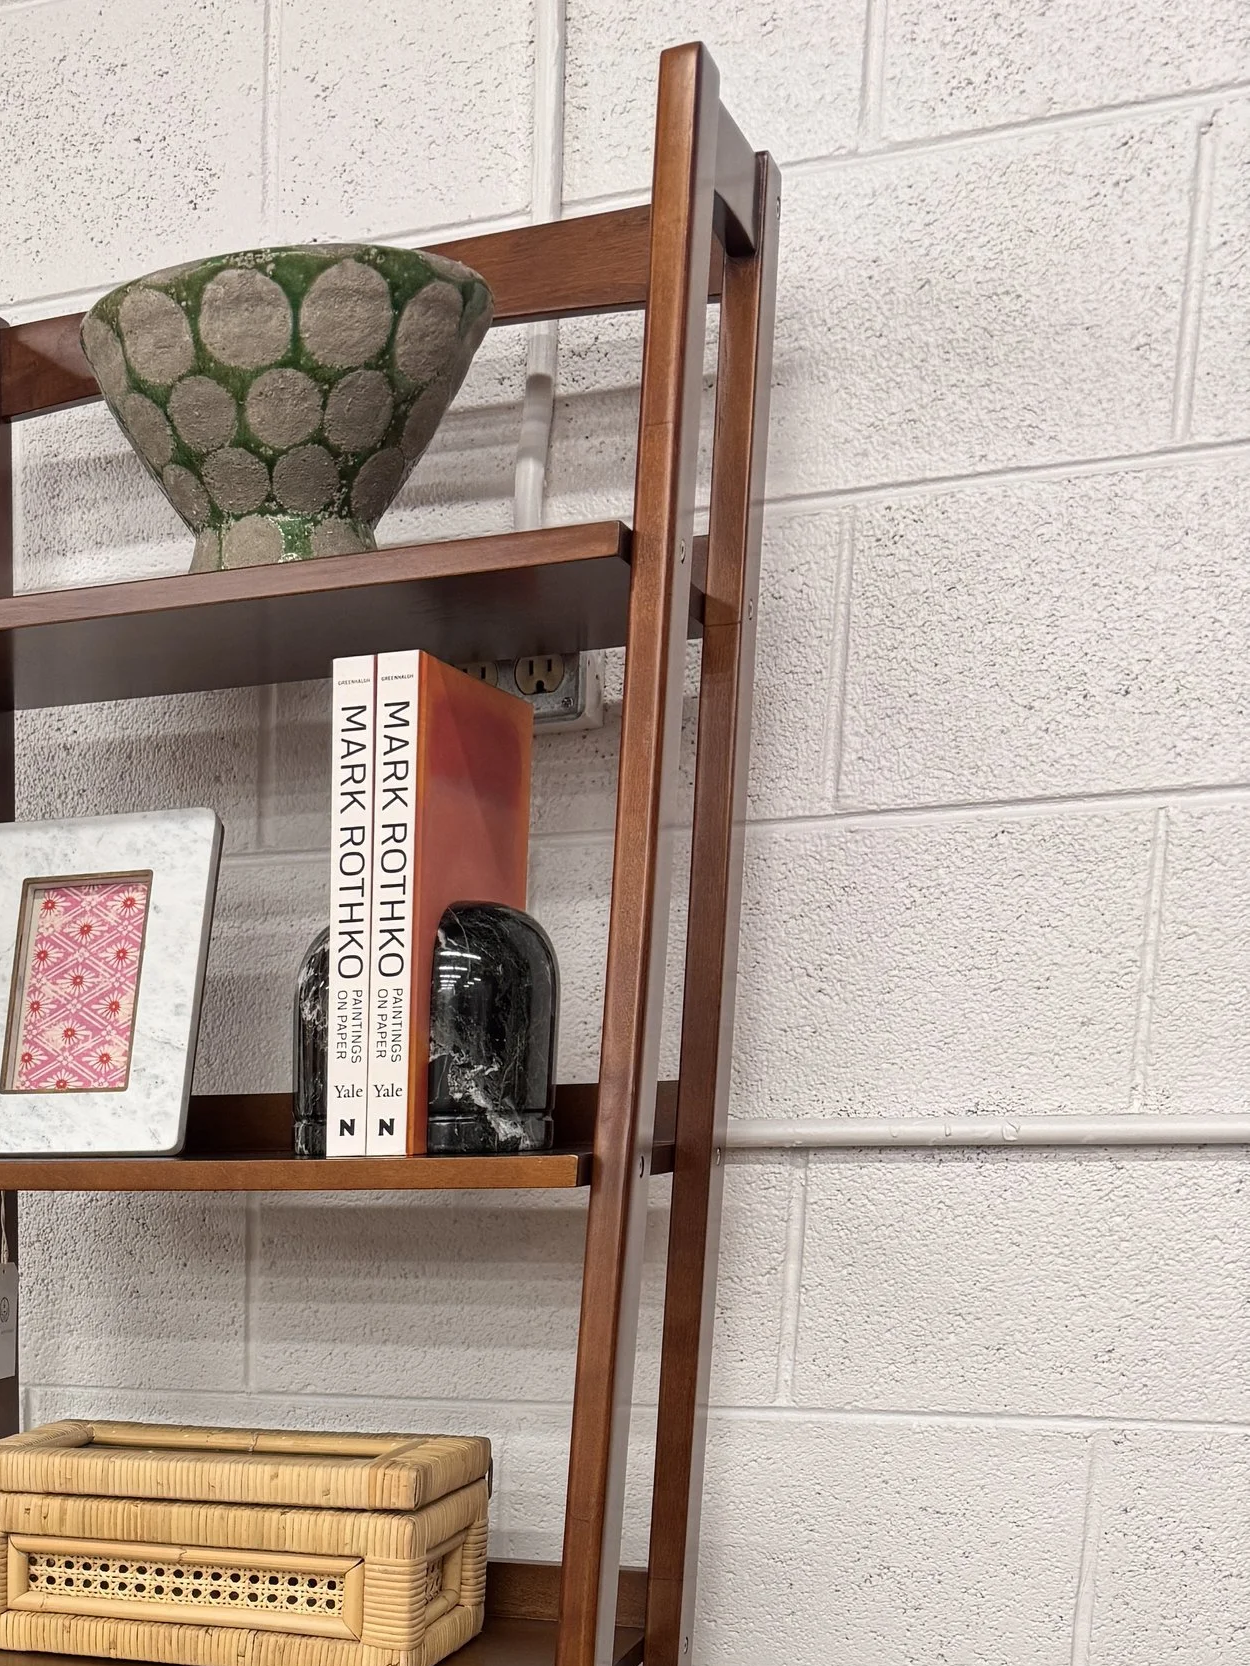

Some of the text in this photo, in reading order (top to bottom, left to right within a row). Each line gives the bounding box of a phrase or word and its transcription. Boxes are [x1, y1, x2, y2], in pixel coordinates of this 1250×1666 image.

[338, 678, 371, 686] GREENHALGH
[381, 674, 414, 682] GREENHALGH
[338, 705, 367, 979] MARK ROTHKO
[378, 701, 410, 978] MARK ROTHKO
[336, 990, 348, 1060] ON PAPER
[351, 989, 363, 1064] PAINTINGS
[376, 988, 389, 1059] ON PAPER
[390, 988, 403, 1063] PAINTINGS
[334, 1084, 363, 1099] Yale
[373, 1083, 403, 1098] Yale
